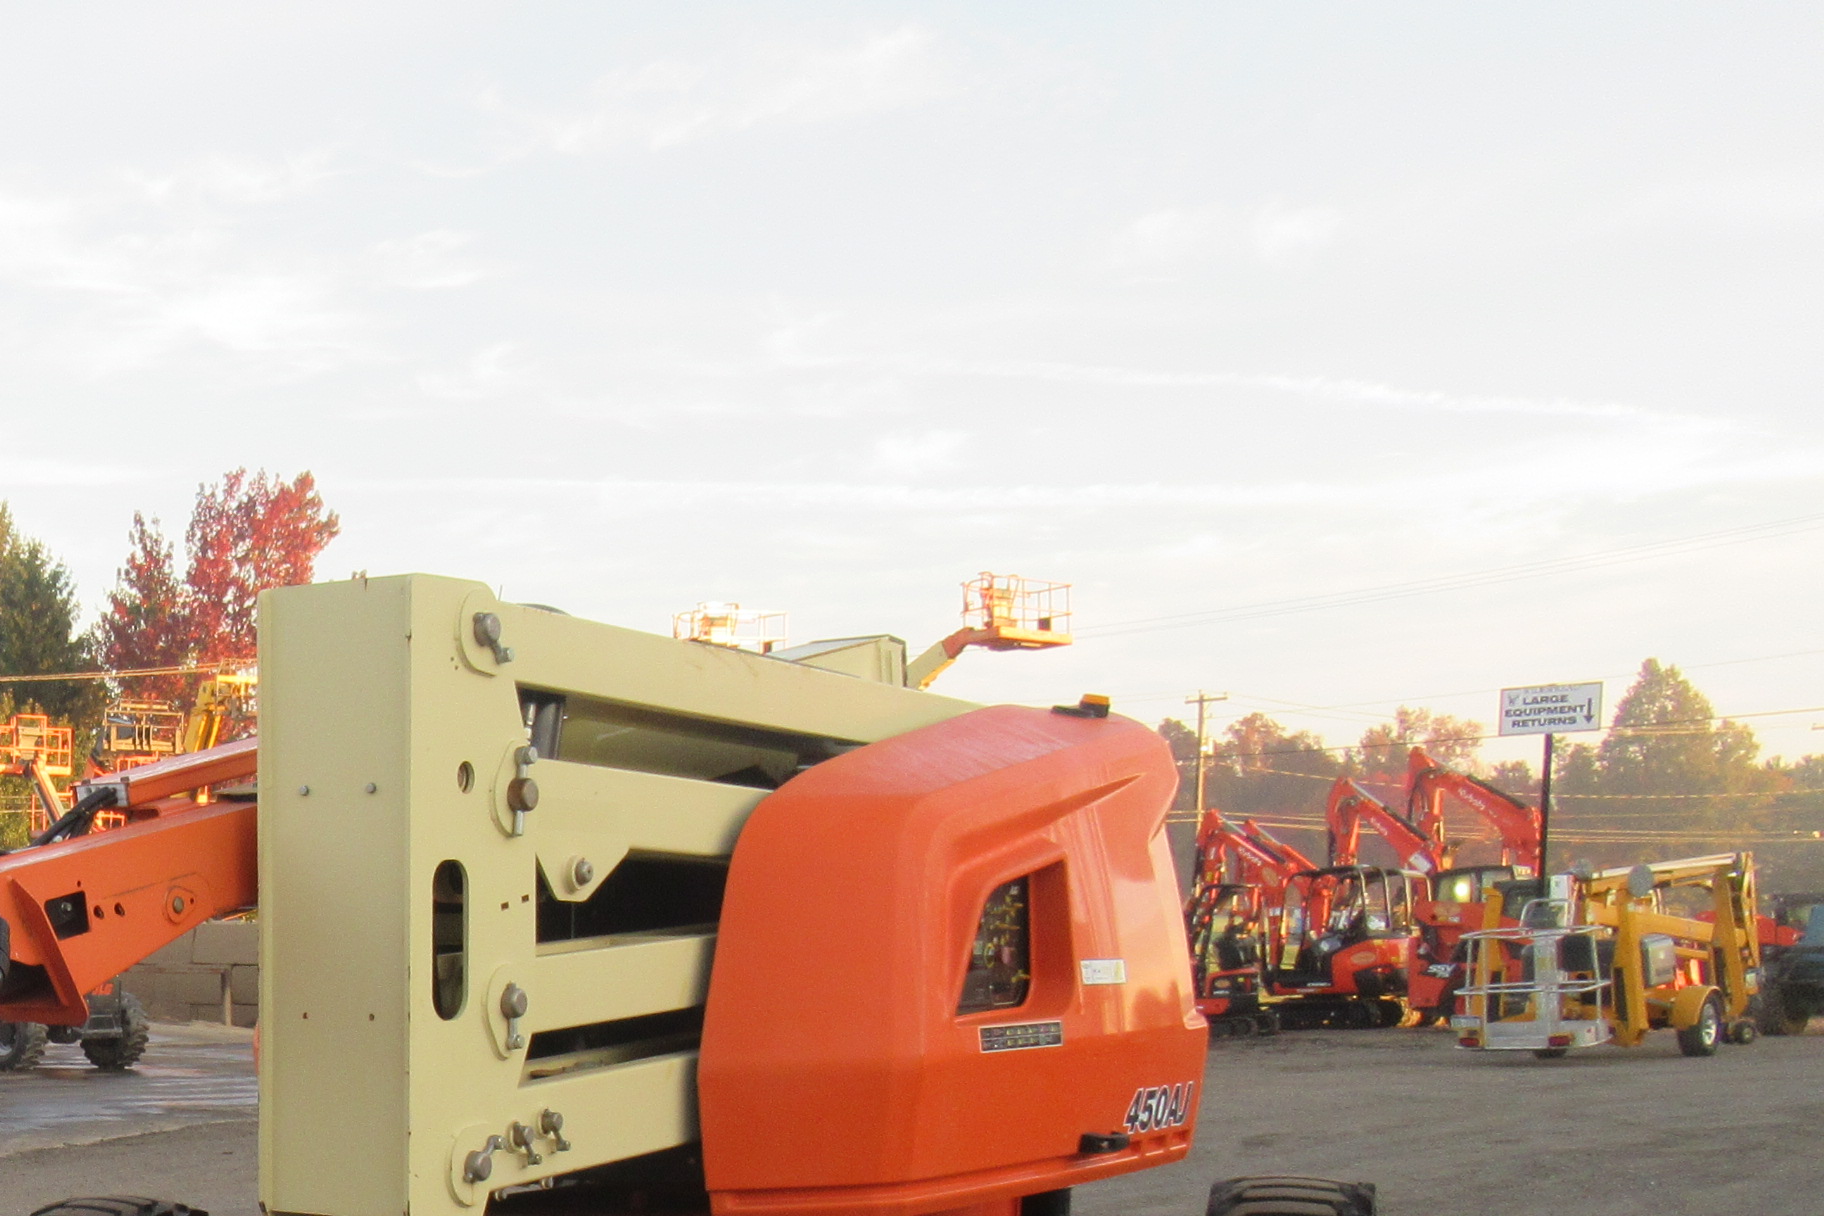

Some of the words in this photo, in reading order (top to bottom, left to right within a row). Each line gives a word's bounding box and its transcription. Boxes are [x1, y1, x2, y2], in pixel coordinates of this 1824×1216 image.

[1523, 695, 1569, 705] LARGE
[1504, 704, 1585, 717] EQUIPMENT
[1511, 716, 1577, 728] RETURNS
[1122, 1081, 1194, 1135] 450AJ
